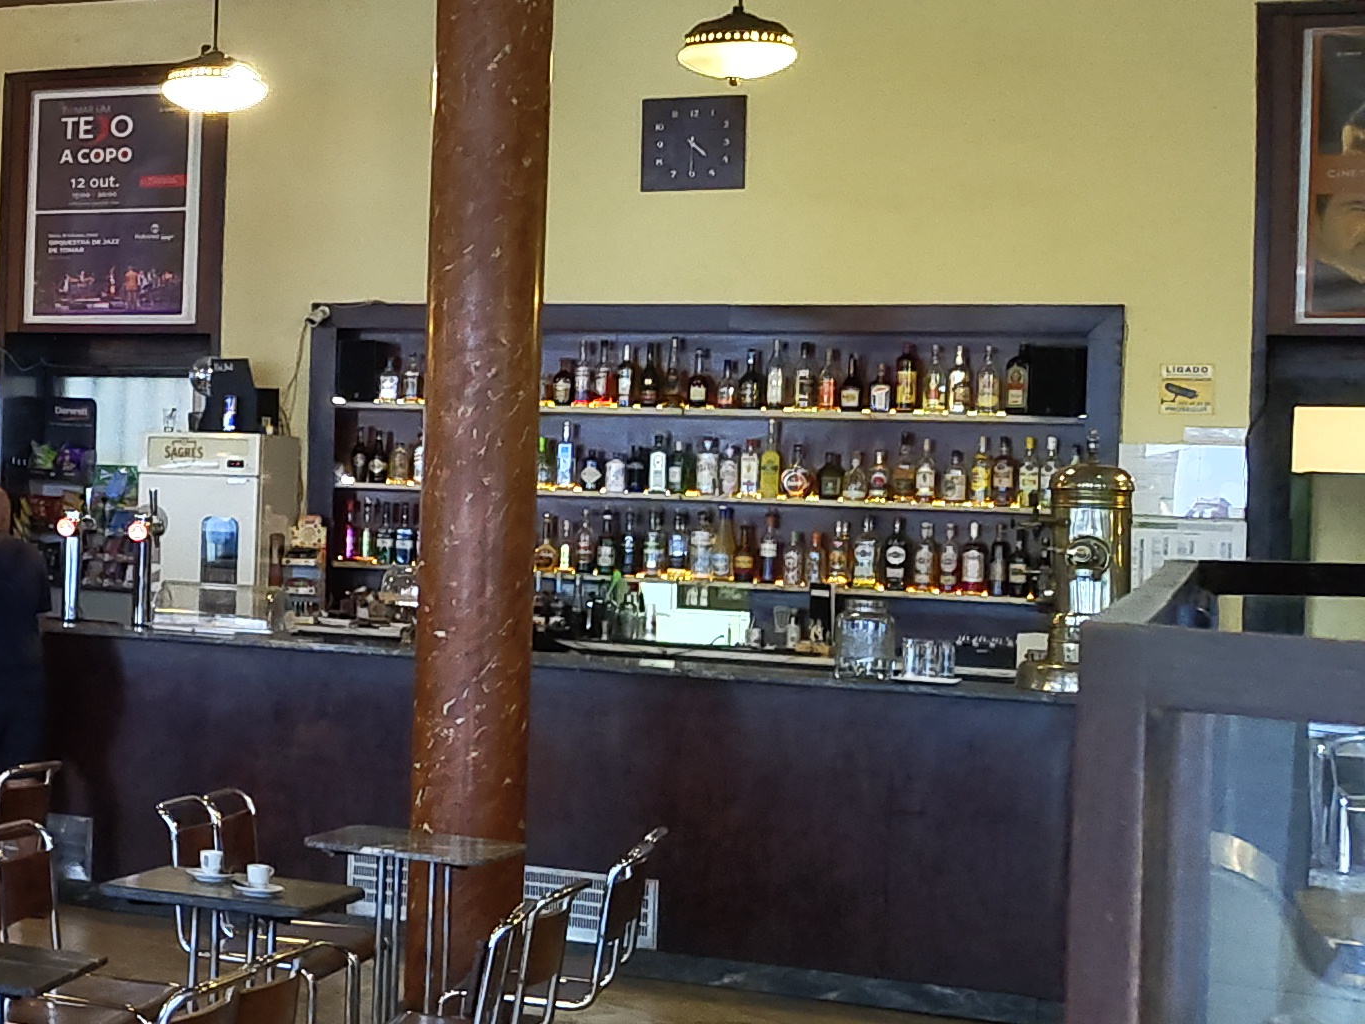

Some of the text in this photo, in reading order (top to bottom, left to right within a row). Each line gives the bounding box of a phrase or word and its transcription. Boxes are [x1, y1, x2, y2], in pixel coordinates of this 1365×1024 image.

[690, 109, 700, 118] 12
[61, 114, 134, 144] TEJO
[655, 123, 665, 131] 10
[59, 147, 133, 164] A COPO
[670, 170, 677, 178] 7
[70, 176, 120, 189] 12 out.
[164, 445, 204, 460] SAGRES
